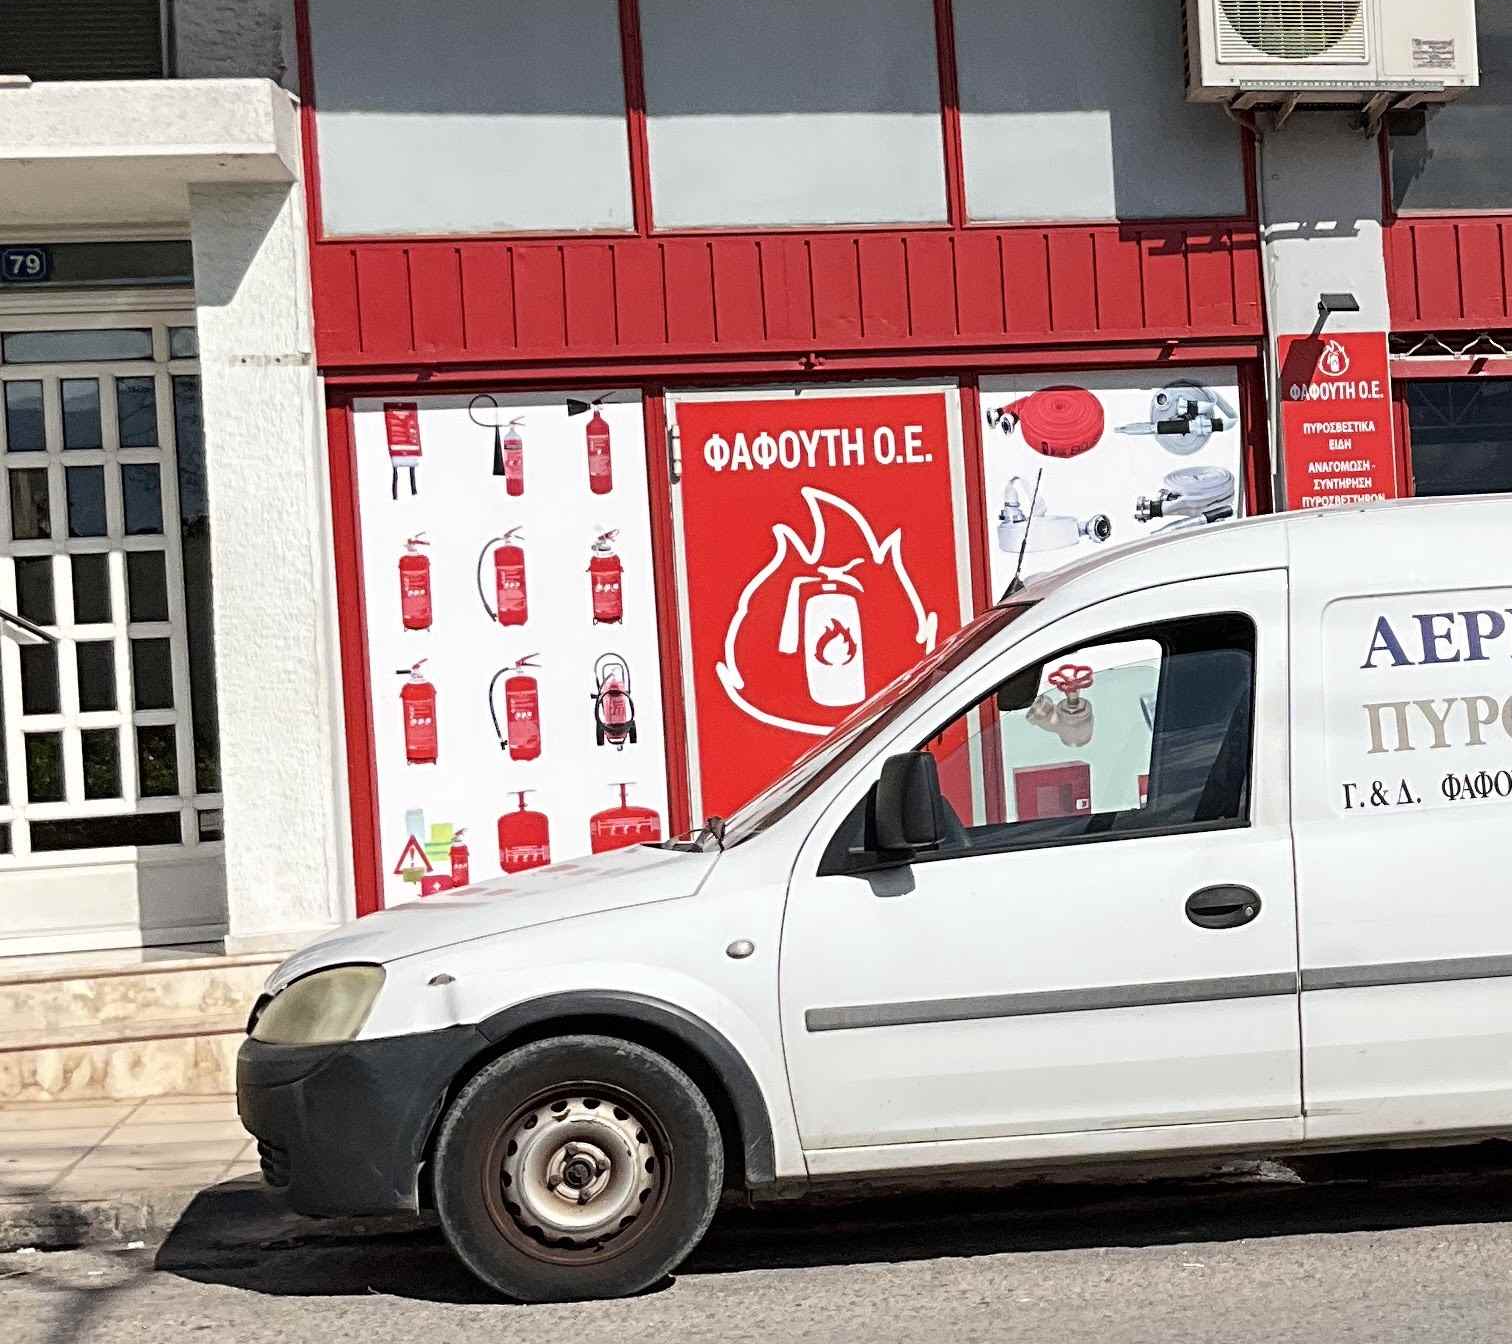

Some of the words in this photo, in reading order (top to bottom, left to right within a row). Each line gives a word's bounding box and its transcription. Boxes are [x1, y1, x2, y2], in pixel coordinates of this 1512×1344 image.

[9, 254, 41, 274] 79
[1290, 382, 1356, 400] ΦΑΦΟΥΤΗ
[1359, 381, 1384, 399] Ο.Ε.
[1303, 421, 1375, 434] ΠΥΡΟΣΒΕΣΤΙΚΑ
[703, 430, 865, 472] ΦΑΦΟΥΤΗ
[873, 425, 933, 465] Ο.Ε.
[1328, 438, 1353, 451] ΕΙΔΗ
[1308, 460, 1370, 473] ΑΝΑΓΟΜΩΣΗ
[1313, 477, 1372, 490] ΣΥΝΤΗΡΗΣΗ
